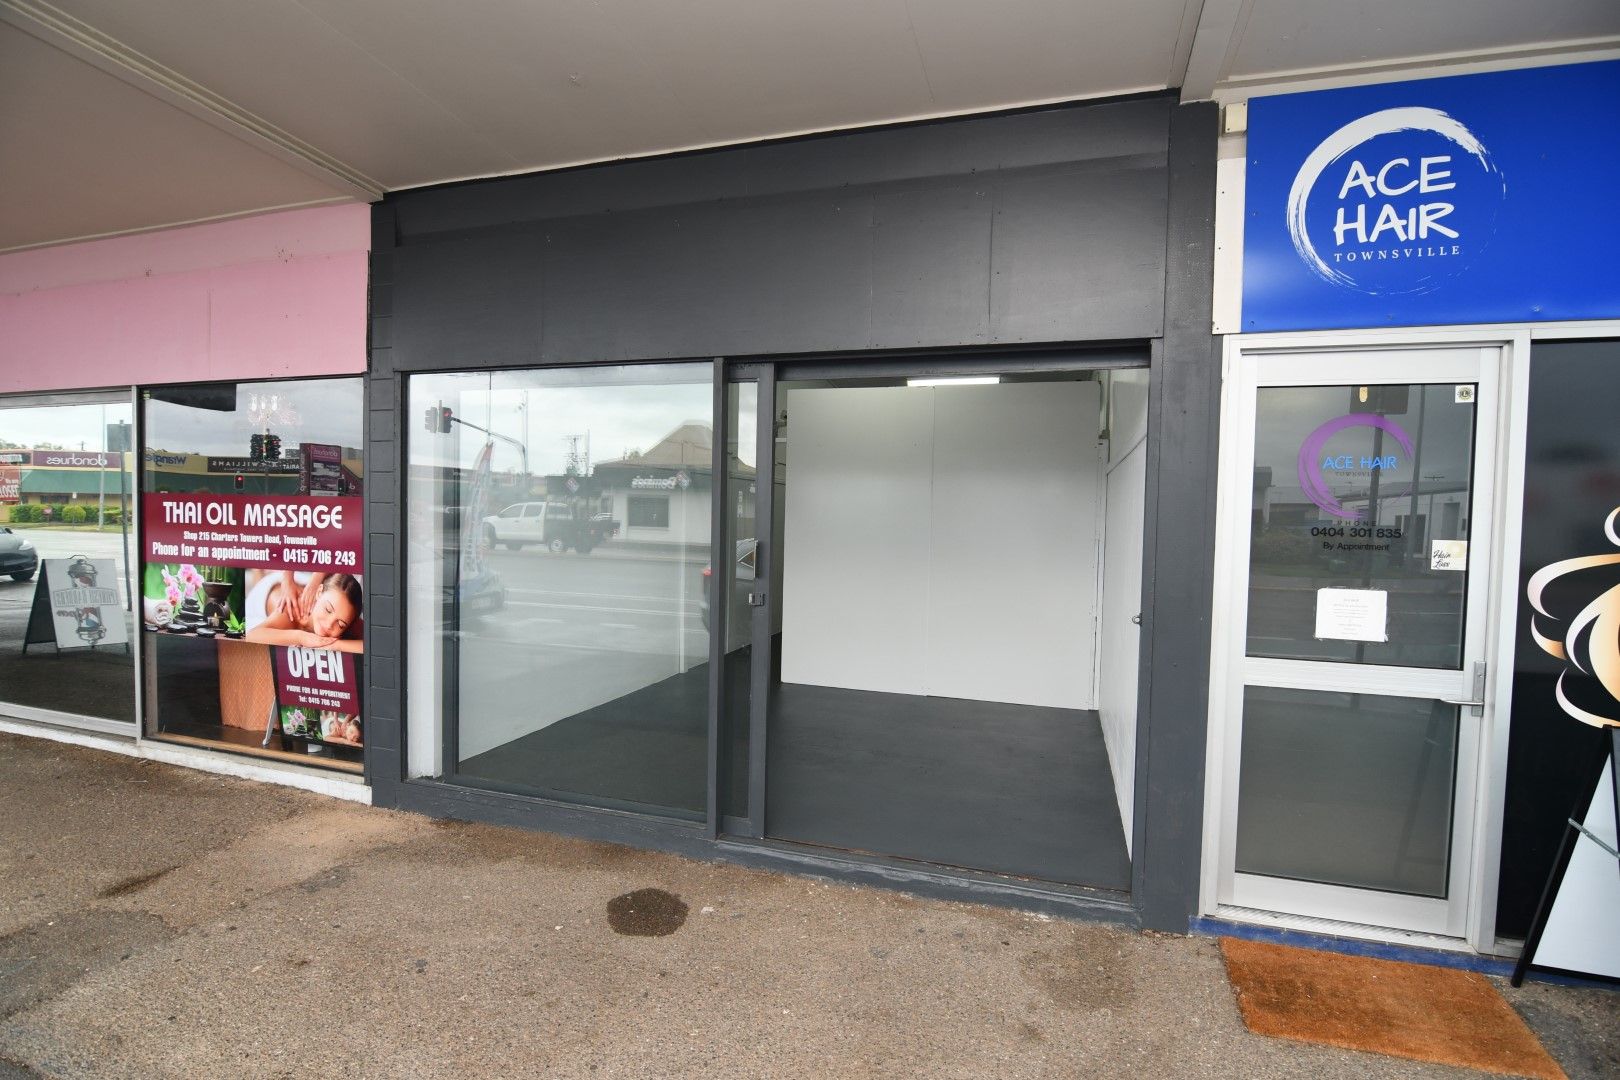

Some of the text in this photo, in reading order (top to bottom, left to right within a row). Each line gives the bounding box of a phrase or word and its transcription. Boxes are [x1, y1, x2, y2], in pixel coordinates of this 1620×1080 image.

[1338, 155, 1457, 199] ACE
[1333, 202, 1460, 246] HAIR
[1334, 245, 1460, 262] TOWNSVILLE
[1322, 455, 1397, 469] ACE HAIR
[163, 501, 343, 529] THAI OIL MASSAGE
[183, 530, 317, 546] Shop 215 Charters Towers Road, Townsville
[1311, 527, 1401, 538] 0404 301 835
[152, 542, 179, 556] Phone
[181, 543, 196, 557] for
[198, 547, 209, 558] an
[211, 546, 270, 562] appointment
[283, 548, 309, 564] 0415
[311, 549, 332, 565] 706
[334, 550, 356, 566] 243
[1323, 542, 1389, 551] By Appointment
[287, 646, 345, 683] OPEN
[286, 684, 301, 693] PHONE
[301, 686, 311, 694] FOR
[311, 687, 319, 695] AN
[299, 695, 307, 703] Tel:
[308, 697, 320, 705] 0415
[320, 698, 330, 706] 706
